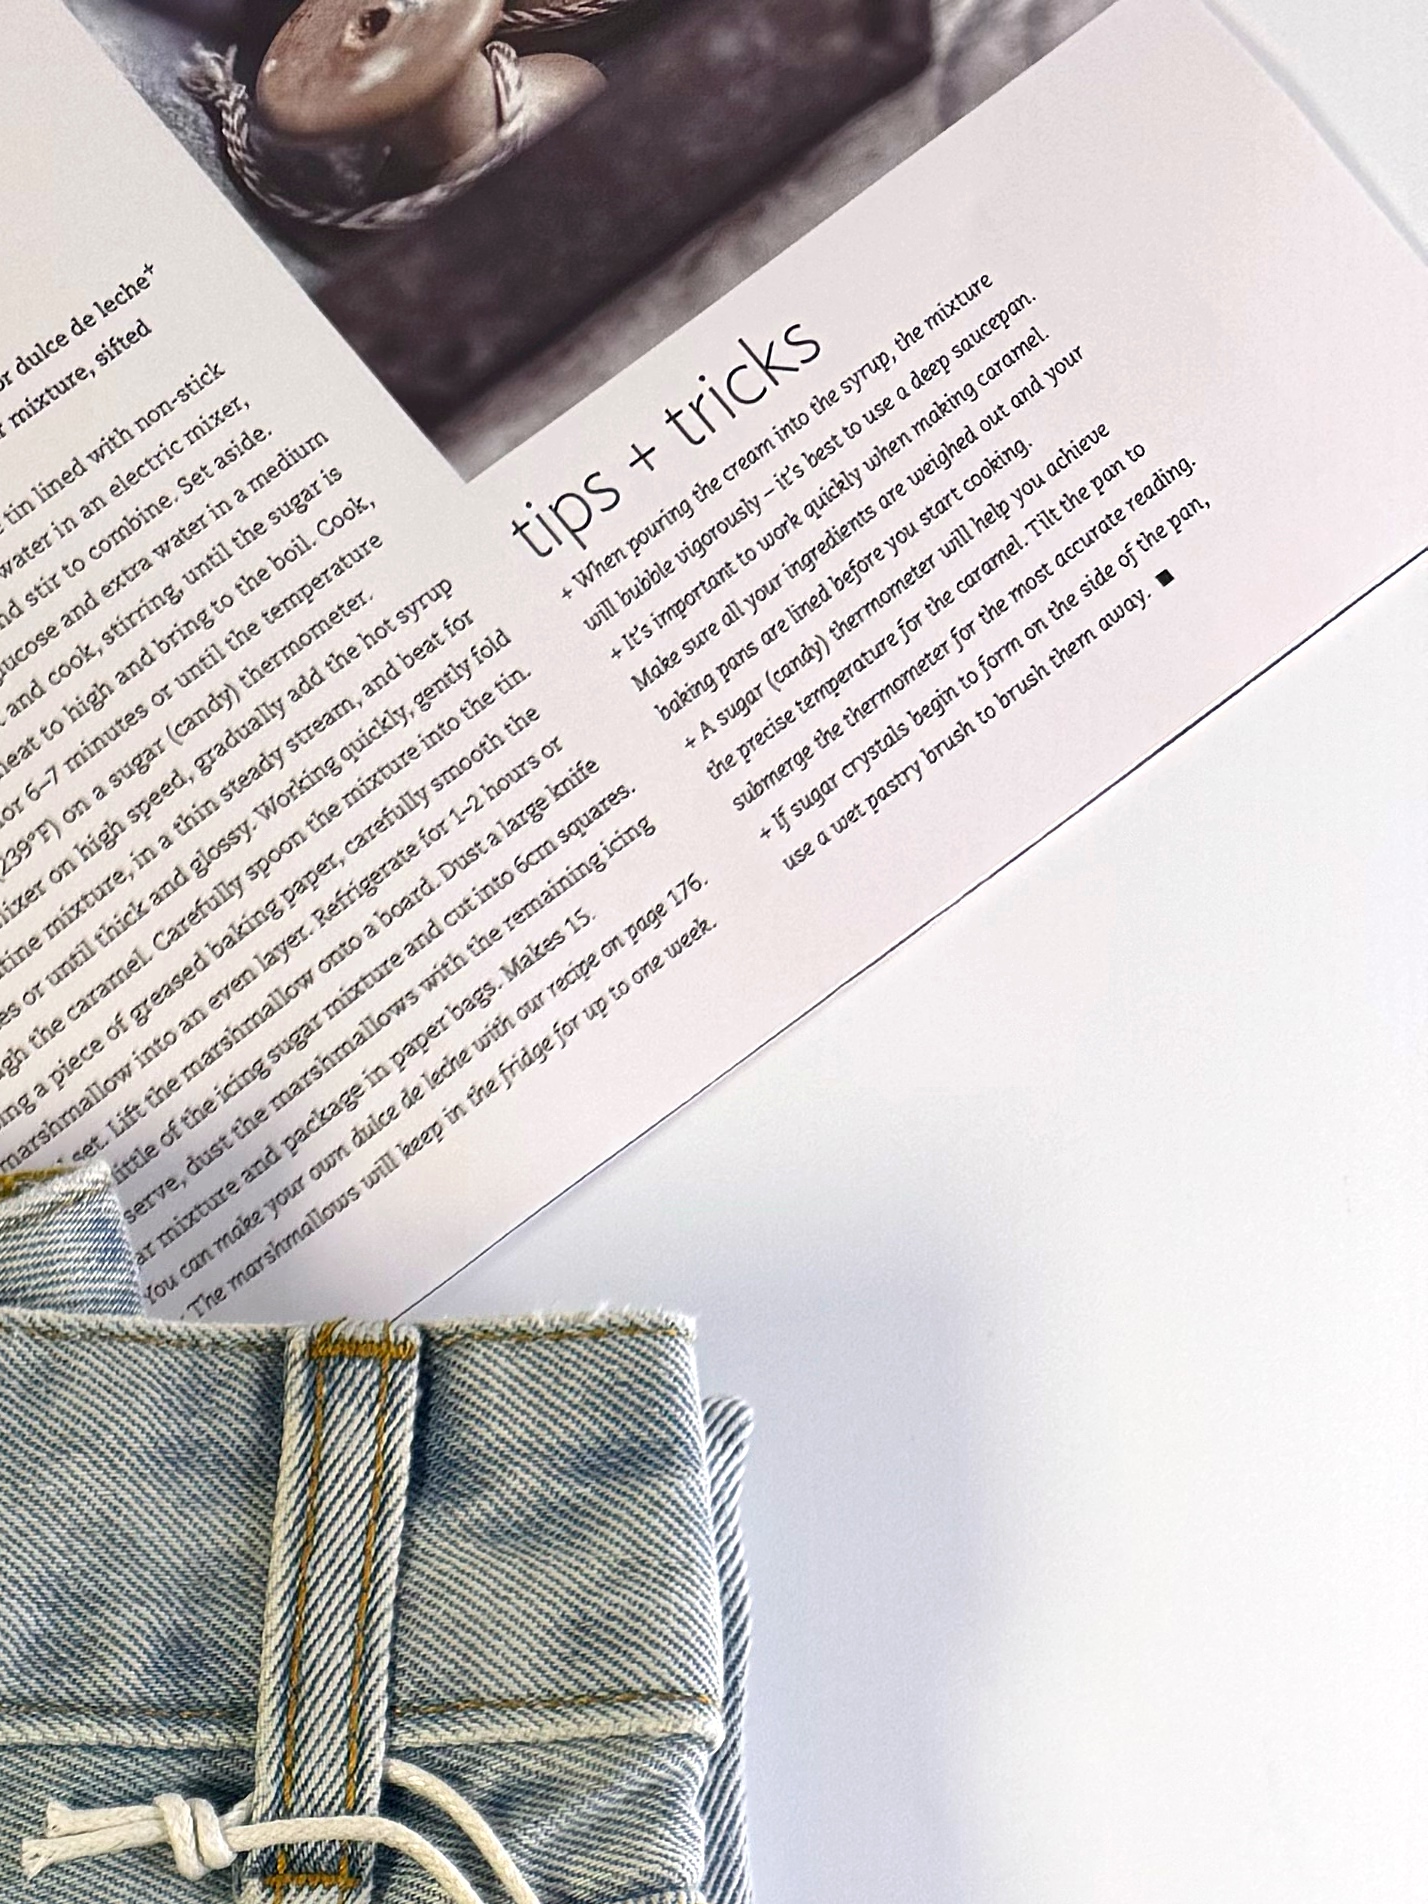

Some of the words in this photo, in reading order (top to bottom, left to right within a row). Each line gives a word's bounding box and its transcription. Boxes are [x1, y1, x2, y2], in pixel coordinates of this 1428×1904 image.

[6, 365, 97, 429] mixture,
[93, 316, 153, 368] sifted
[14, 332, 70, 376] dulce
[69, 312, 98, 337] de
[49, 514, 80, 540] in
[77, 494, 109, 520] an
[107, 438, 185, 498] electric
[181, 394, 251, 446] mixer,
[510, 469, 621, 558] tips
[627, 441, 656, 472] +
[663, 321, 822, 446] tricks
[23, 571, 62, 608] stir
[59, 556, 86, 579] to
[87, 493, 179, 561] combine.
[175, 463, 215, 496] Set
[212, 427, 273, 471] aside.
[628, 649, 683, 693] Make
[680, 621, 721, 657] sure
[719, 598, 747, 628] all
[741, 570, 783, 617] your
[779, 503, 878, 580] ingredients
[876, 481, 908, 510] are
[904, 423, 980, 487] weighed
[977, 402, 1012, 433] out
[1008, 372, 1046, 410] and
[1041, 344, 1084, 389] your
[652, 671, 720, 722] baking
[713, 639, 760, 684] pans
[758, 617, 791, 647] are
[783, 581, 833, 625] lined
[825, 545, 886, 593] before
[881, 520, 921, 558] you
[917, 486, 965, 527] start
[961, 437, 1033, 493] cooking.
[704, 751, 739, 781] the
[734, 708, 798, 765] precise
[793, 631, 900, 715] temperature
[895, 609, 924, 646] for
[922, 588, 956, 617] the
[954, 532, 1029, 595] caramel.
[1022, 506, 1063, 538] Tilt
[1057, 484, 1092, 514] the
[1087, 458, 1128, 497] pan
[1123, 442, 1146, 463] to
[731, 743, 815, 812] submerge
[811, 721, 845, 750] the
[840, 638, 951, 728] thermometer
[948, 618, 977, 654] for
[976, 596, 1010, 625] the
[1006, 561, 1055, 604] most
[1053, 506, 1127, 569] accurate
[1123, 456, 1197, 513] reading.
[780, 840, 816, 871] use
[815, 828, 833, 847] a
[827, 801, 868, 835] wet
[862, 758, 924, 816] pastry
[917, 718, 978, 765] brush
[973, 703, 997, 725] to
[990, 662, 1052, 710] brush
[1047, 627, 1099, 669] them
[1096, 587, 1152, 633] away.
[31, 1080, 51, 1099] a
[46, 1035, 106, 1092] piece
[104, 1009, 130, 1042] of
[128, 948, 211, 1028] greased
[202, 895, 286, 960] baking
[277, 850, 346, 910] paper,
[343, 783, 431, 856] carefully
[428, 731, 507, 793] smooth
[502, 706, 541, 737] the
